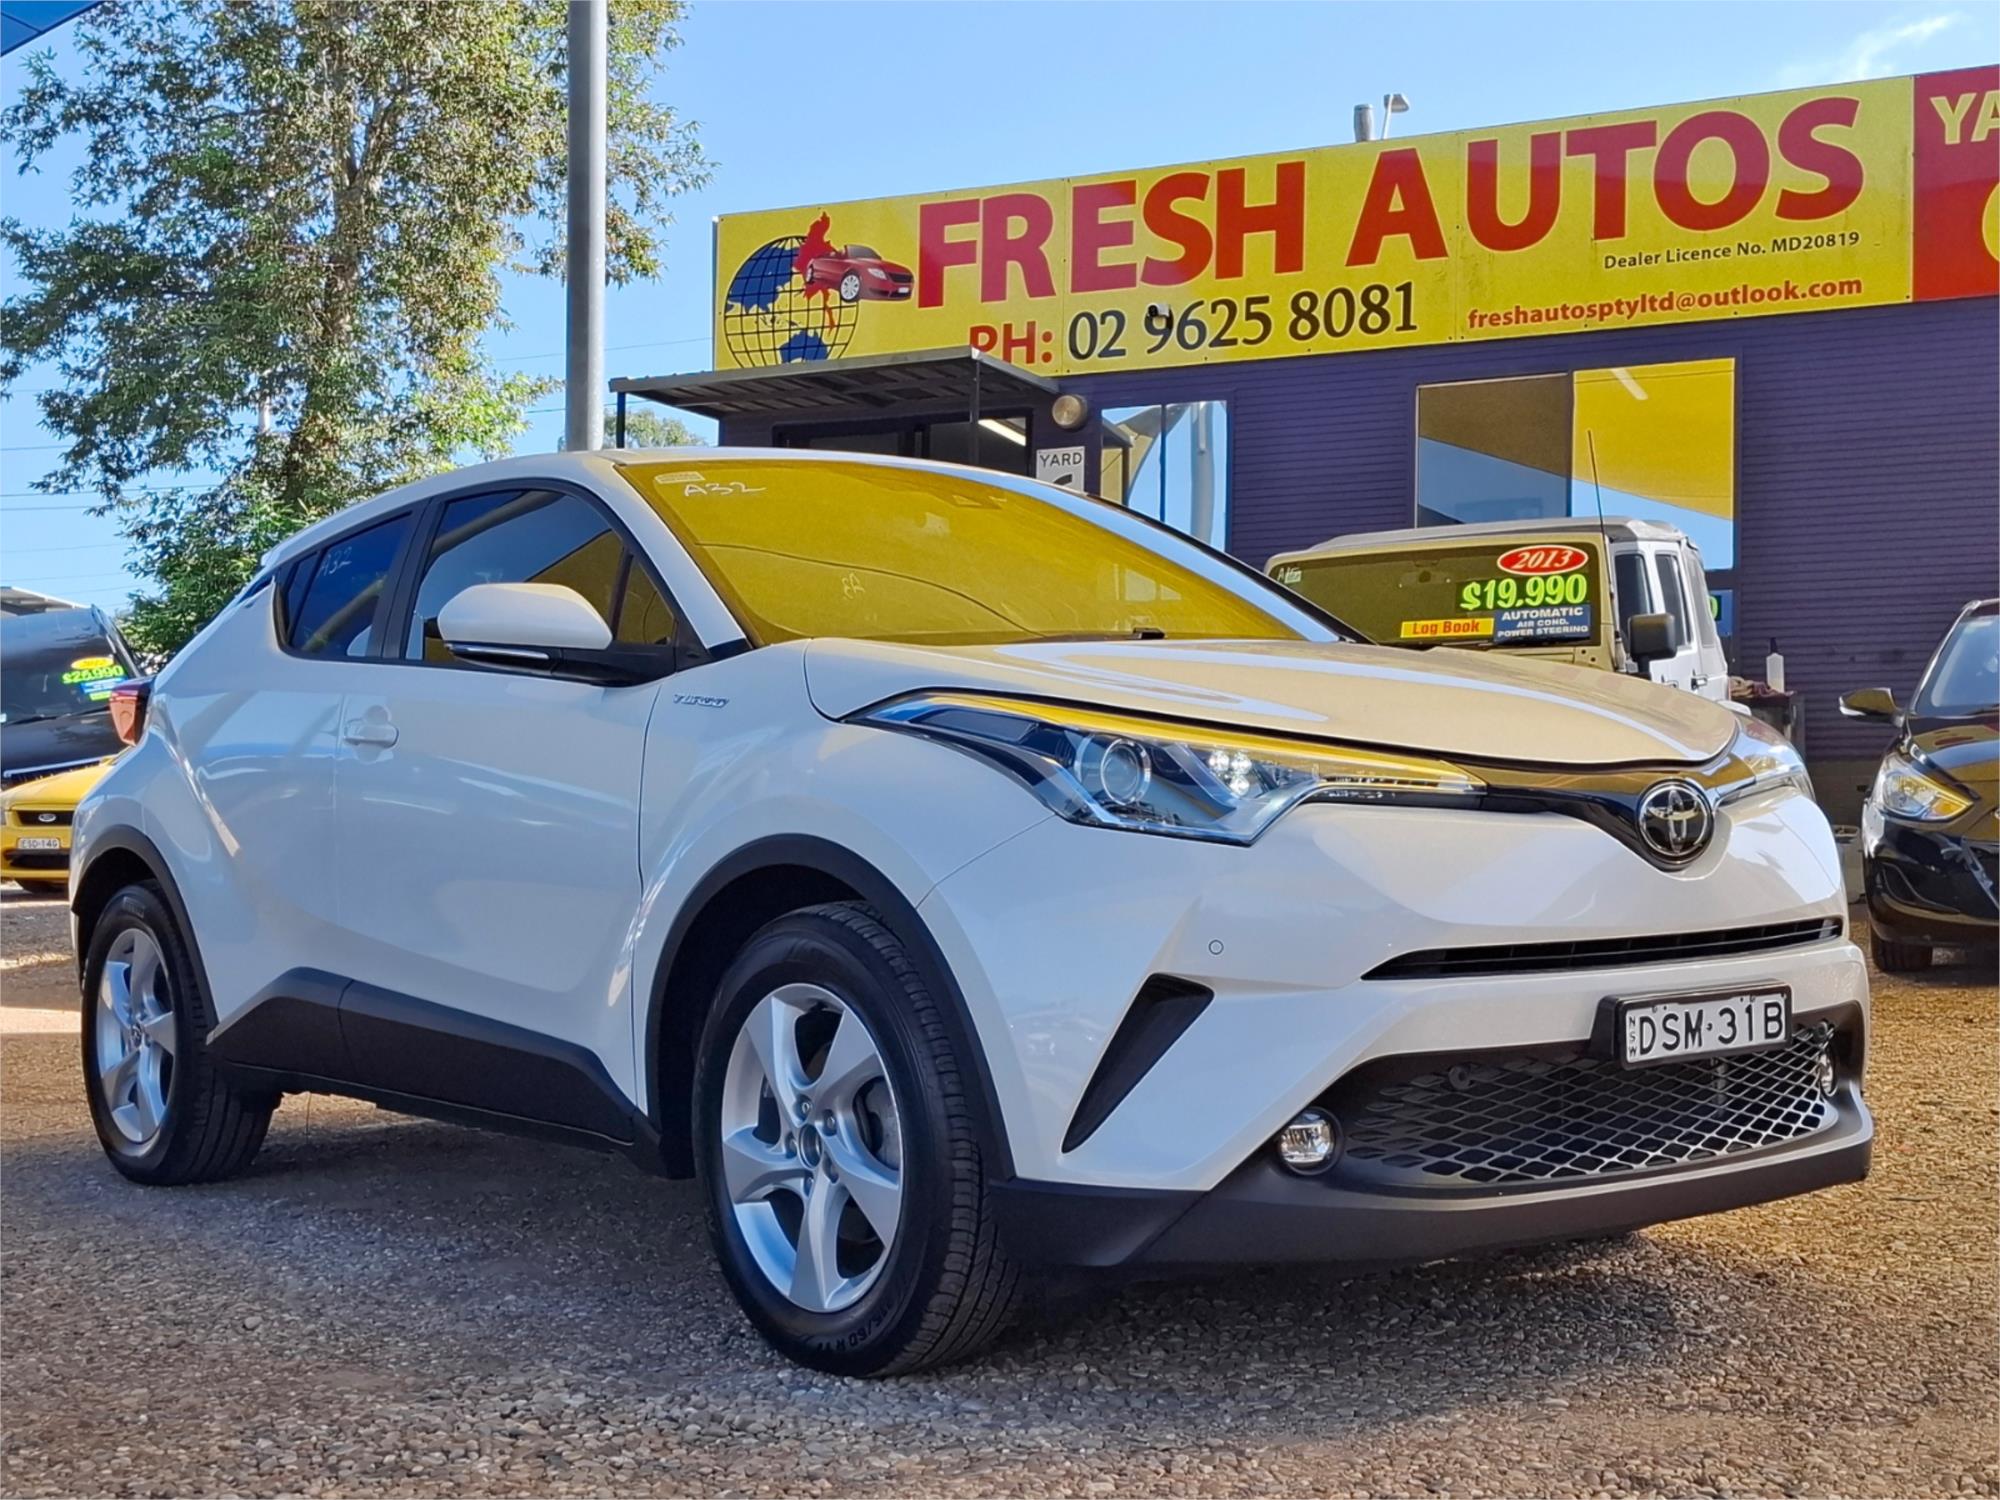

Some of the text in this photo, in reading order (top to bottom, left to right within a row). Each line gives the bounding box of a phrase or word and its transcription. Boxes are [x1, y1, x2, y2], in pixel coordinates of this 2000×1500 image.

[918, 161, 1305, 308] FRESH
[1345, 97, 1864, 266] AUTOS
[1604, 232, 1859, 269] Dealer Licence No. MD20819
[1468, 279, 1862, 329] freshautosptyltd@outlook.com
[969, 281, 1417, 364] PH: 02 9625 8081
[1040, 452, 1082, 467] YARD
[684, 482, 767, 496] A32
[1512, 550, 1573, 569] 2013
[1502, 607, 1584, 620] AUTOMATIC
[1412, 620, 1480, 634] Log Book
[1517, 618, 1569, 628] AIR COND.
[1497, 625, 1589, 638] POWER STEERING
